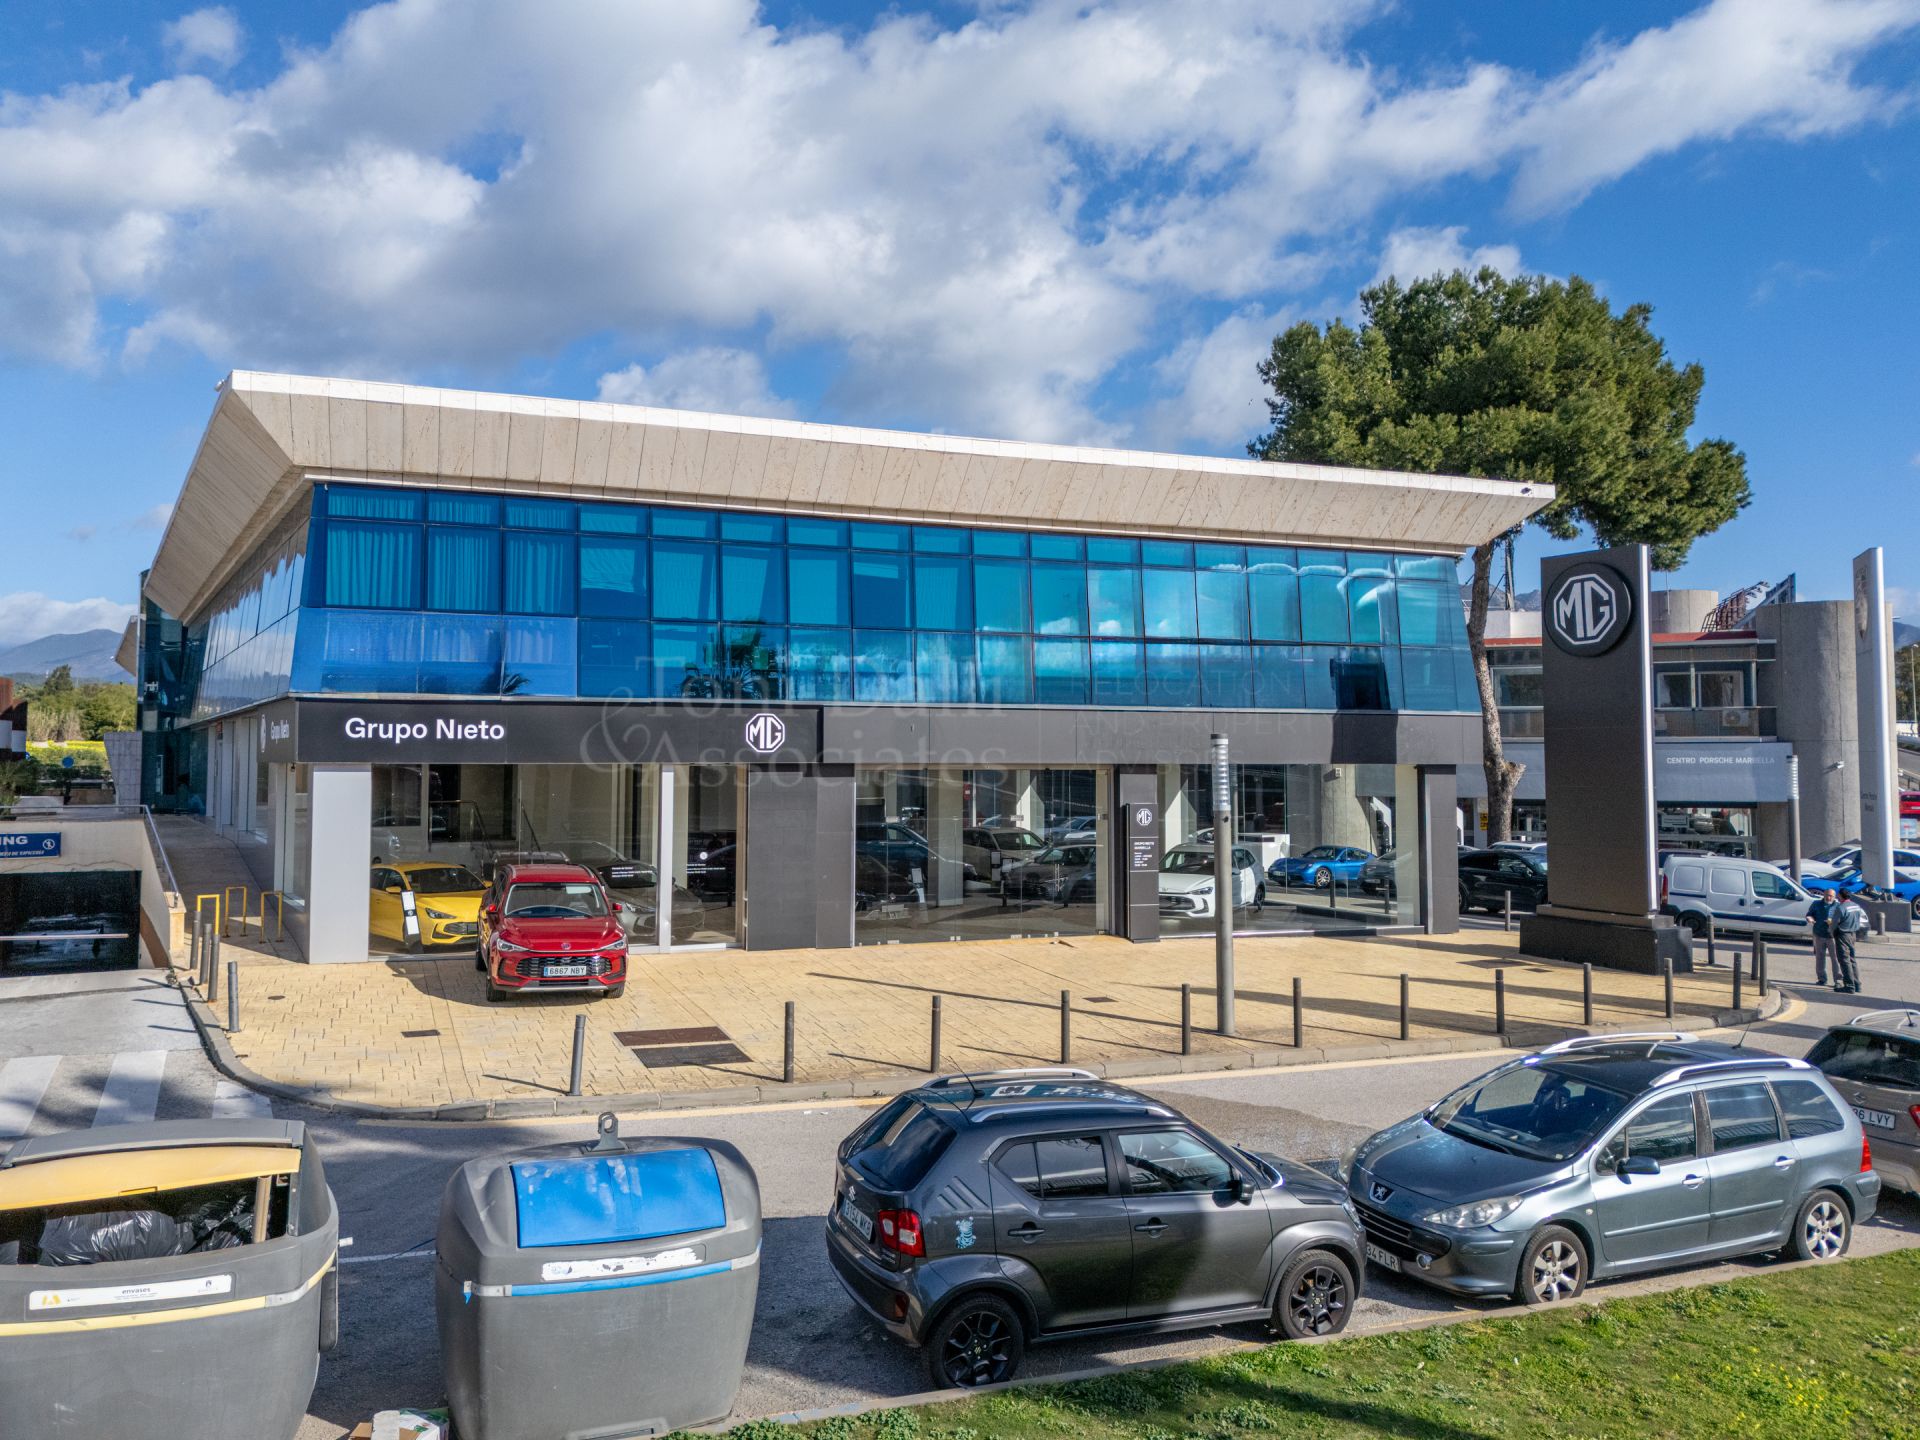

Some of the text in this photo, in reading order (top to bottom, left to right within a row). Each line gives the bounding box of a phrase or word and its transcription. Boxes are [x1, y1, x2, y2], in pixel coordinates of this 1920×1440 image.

[1558, 579, 1611, 640] MG
[344, 717, 505, 744] Grupo Nieto
[749, 716, 782, 749] MG
[1138, 810, 1151, 825] MG
[549, 967, 585, 975] 6867 NBY
[1869, 1112, 1890, 1126] LVY
[1378, 1250, 1396, 1269] FLR
[121, 1287, 151, 1295] envases
